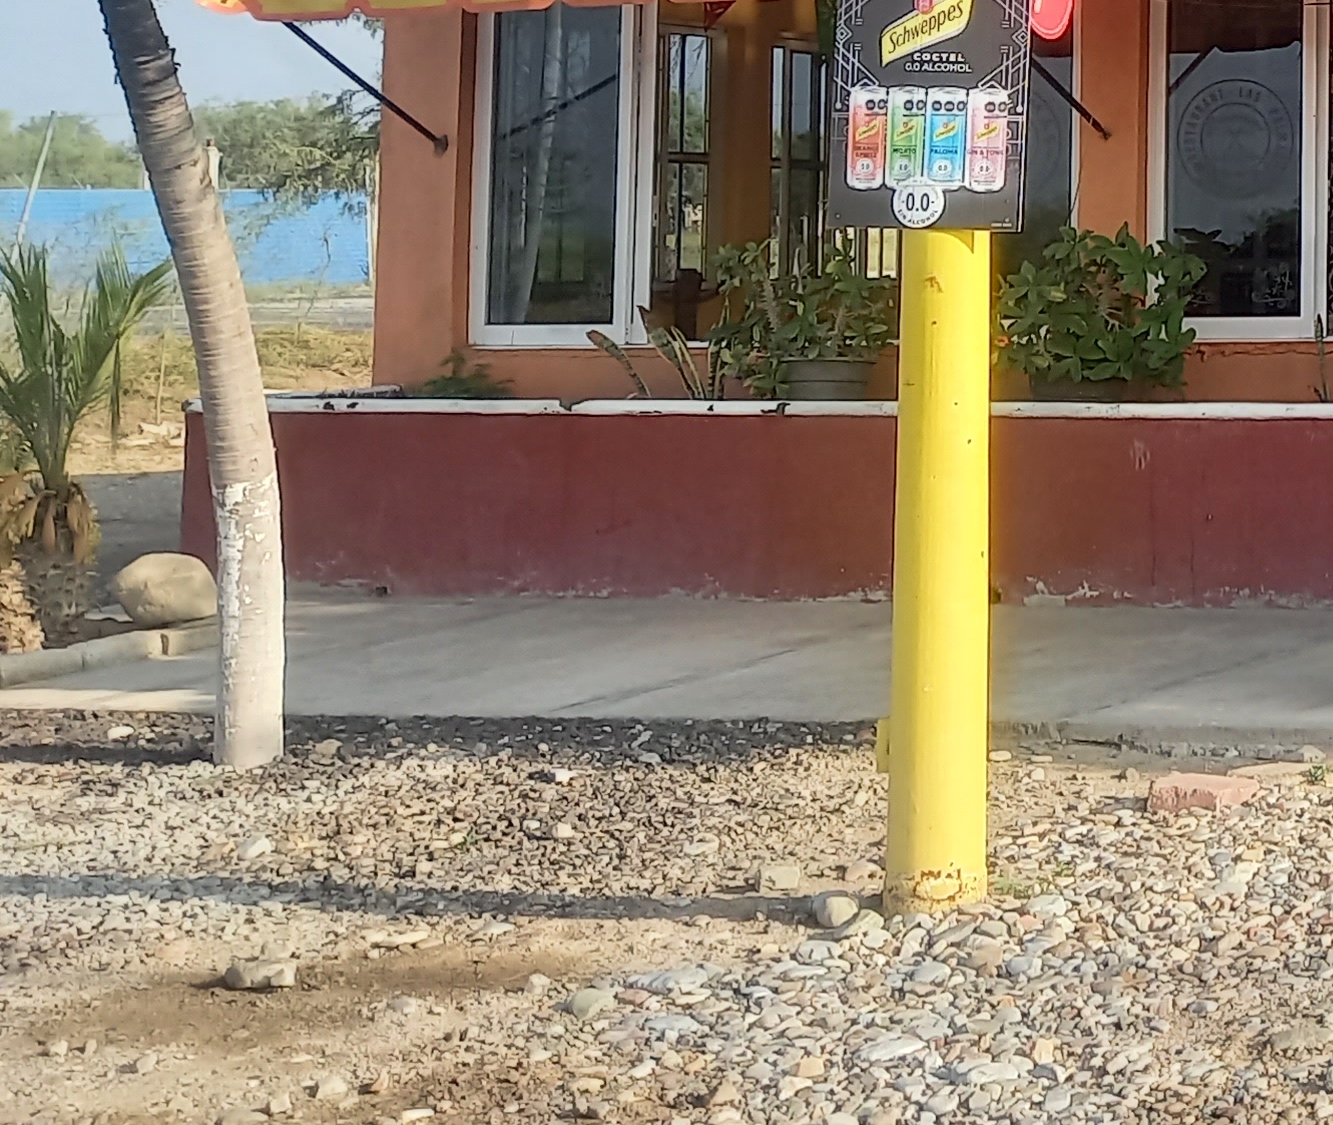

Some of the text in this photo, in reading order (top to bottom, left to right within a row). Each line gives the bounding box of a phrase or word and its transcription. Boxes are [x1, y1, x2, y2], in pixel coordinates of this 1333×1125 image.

[887, 0, 965, 54] Schweppes
[913, 52, 966, 62] COCTEL
[921, 62, 973, 73] ALCOHOL
